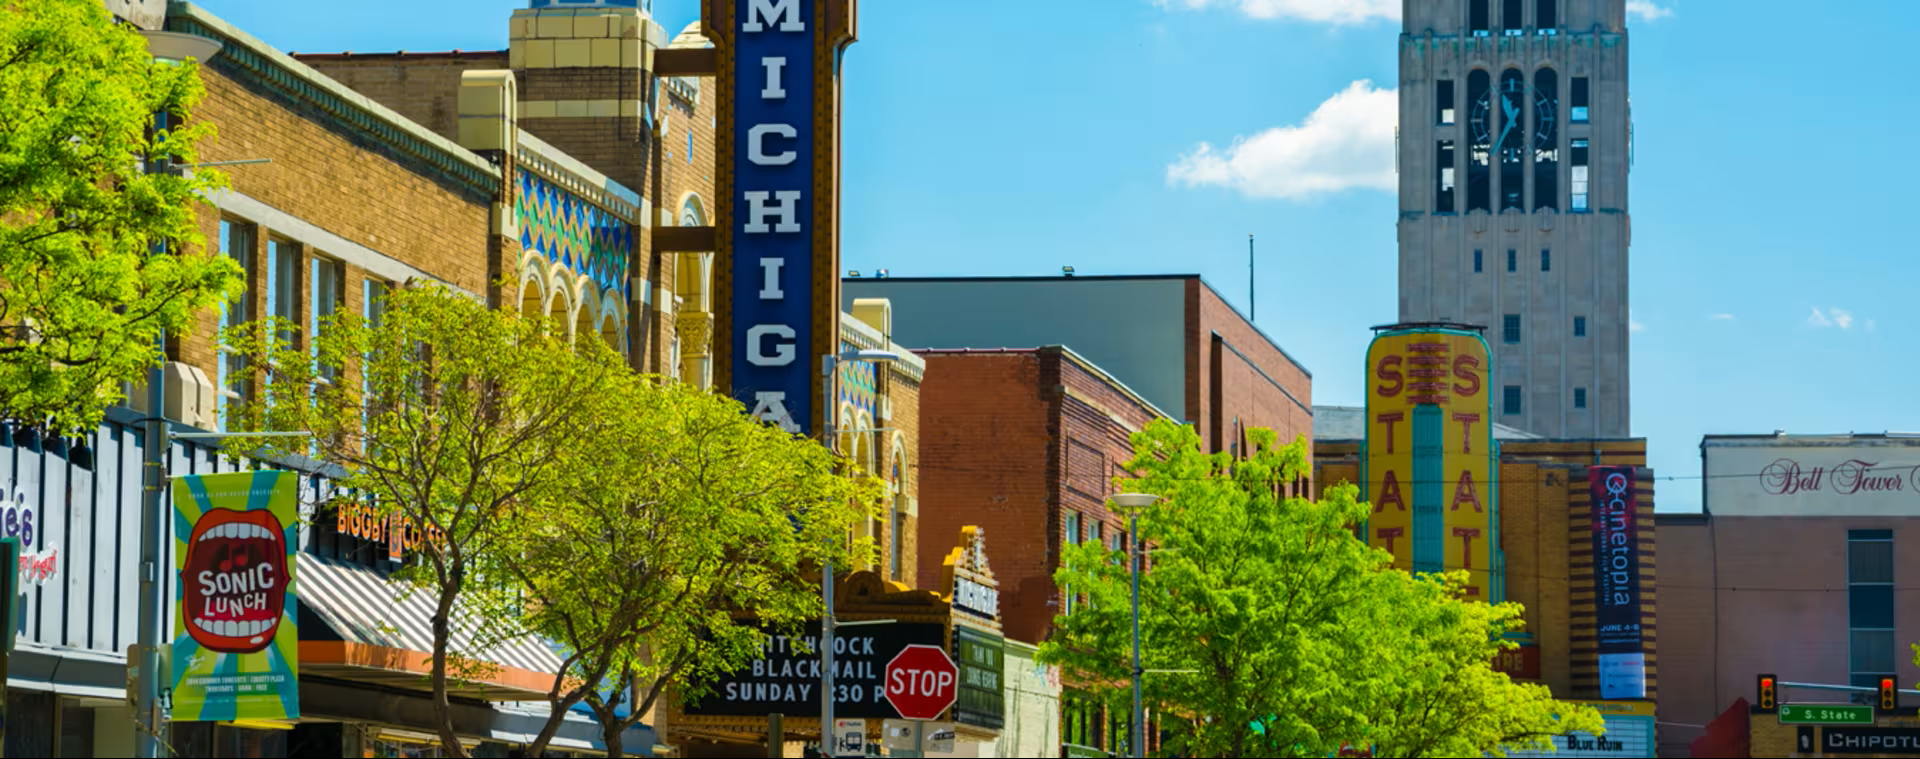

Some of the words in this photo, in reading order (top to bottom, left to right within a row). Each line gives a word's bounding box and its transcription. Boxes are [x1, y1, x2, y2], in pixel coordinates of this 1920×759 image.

[1759, 458, 1823, 495] Bell
[1830, 459, 1904, 495] Tower
[1610, 500, 1630, 606] cinetopia
[198, 561, 274, 598] SONIC
[204, 592, 266, 617] LUNCH
[1600, 624, 1621, 632] JUNE
[726, 682, 811, 702] SUNDAY
[890, 667, 953, 698] STOP
[1805, 710, 1815, 720] S.
[1821, 710, 1857, 720] State
